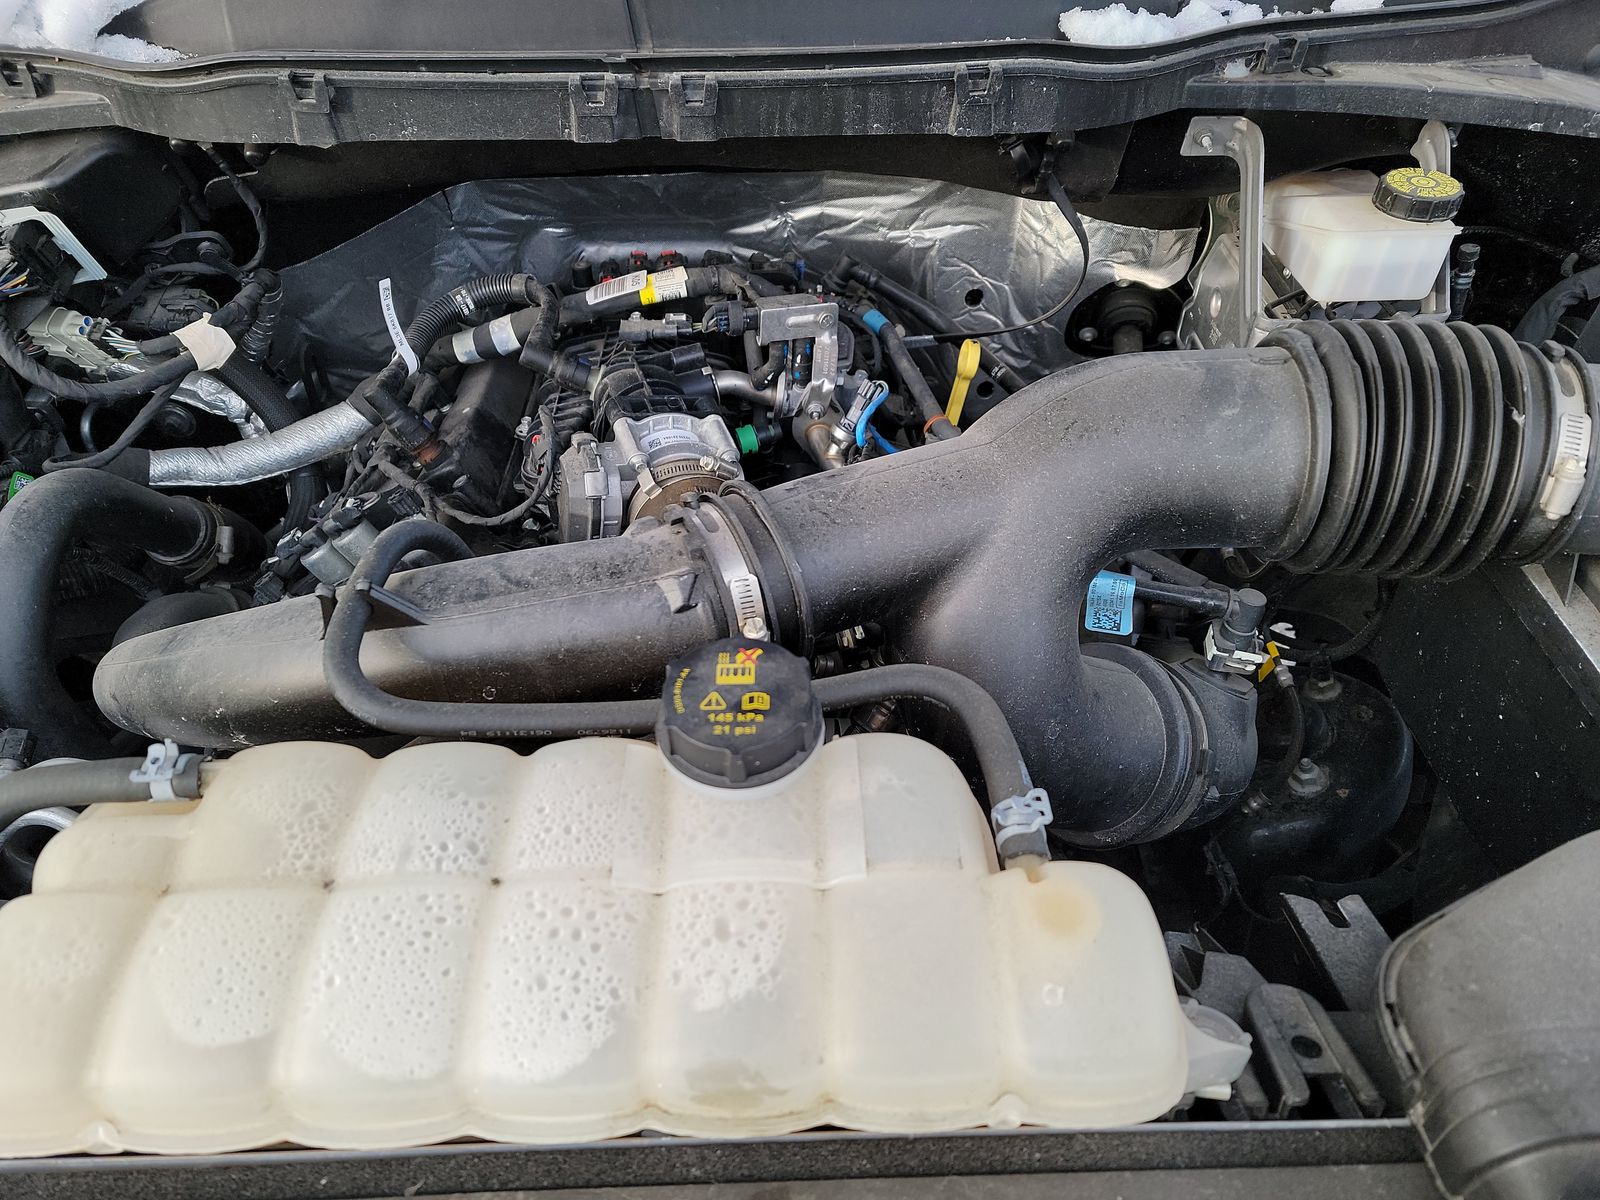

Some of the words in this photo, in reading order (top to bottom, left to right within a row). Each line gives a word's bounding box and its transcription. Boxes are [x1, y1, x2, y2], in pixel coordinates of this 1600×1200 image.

[707, 712, 734, 723] 145
[736, 712, 765, 723] kPa
[712, 724, 731, 735] 21
[734, 724, 757, 736] psi
